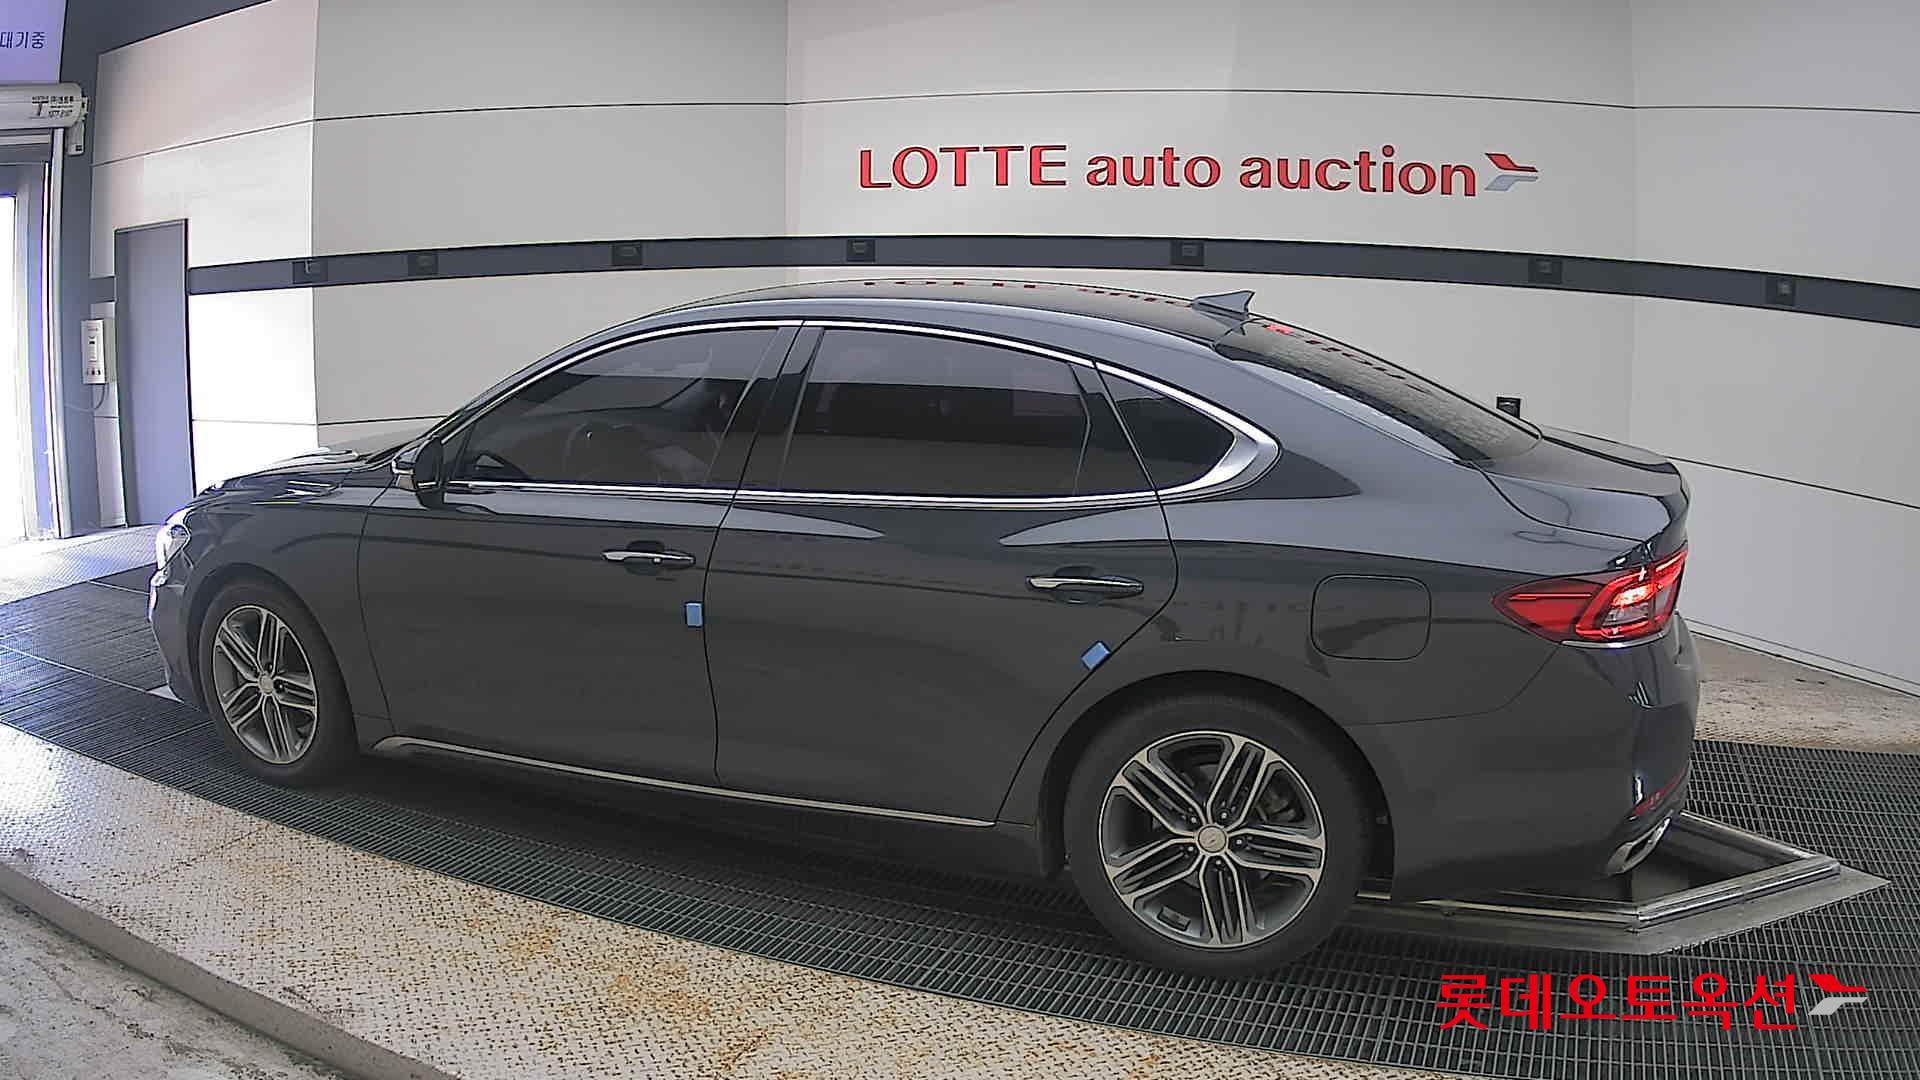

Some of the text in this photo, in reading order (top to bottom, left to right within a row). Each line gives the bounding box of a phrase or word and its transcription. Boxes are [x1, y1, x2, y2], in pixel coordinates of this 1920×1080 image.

[859, 144, 1478, 197] LOTTE auto auction
